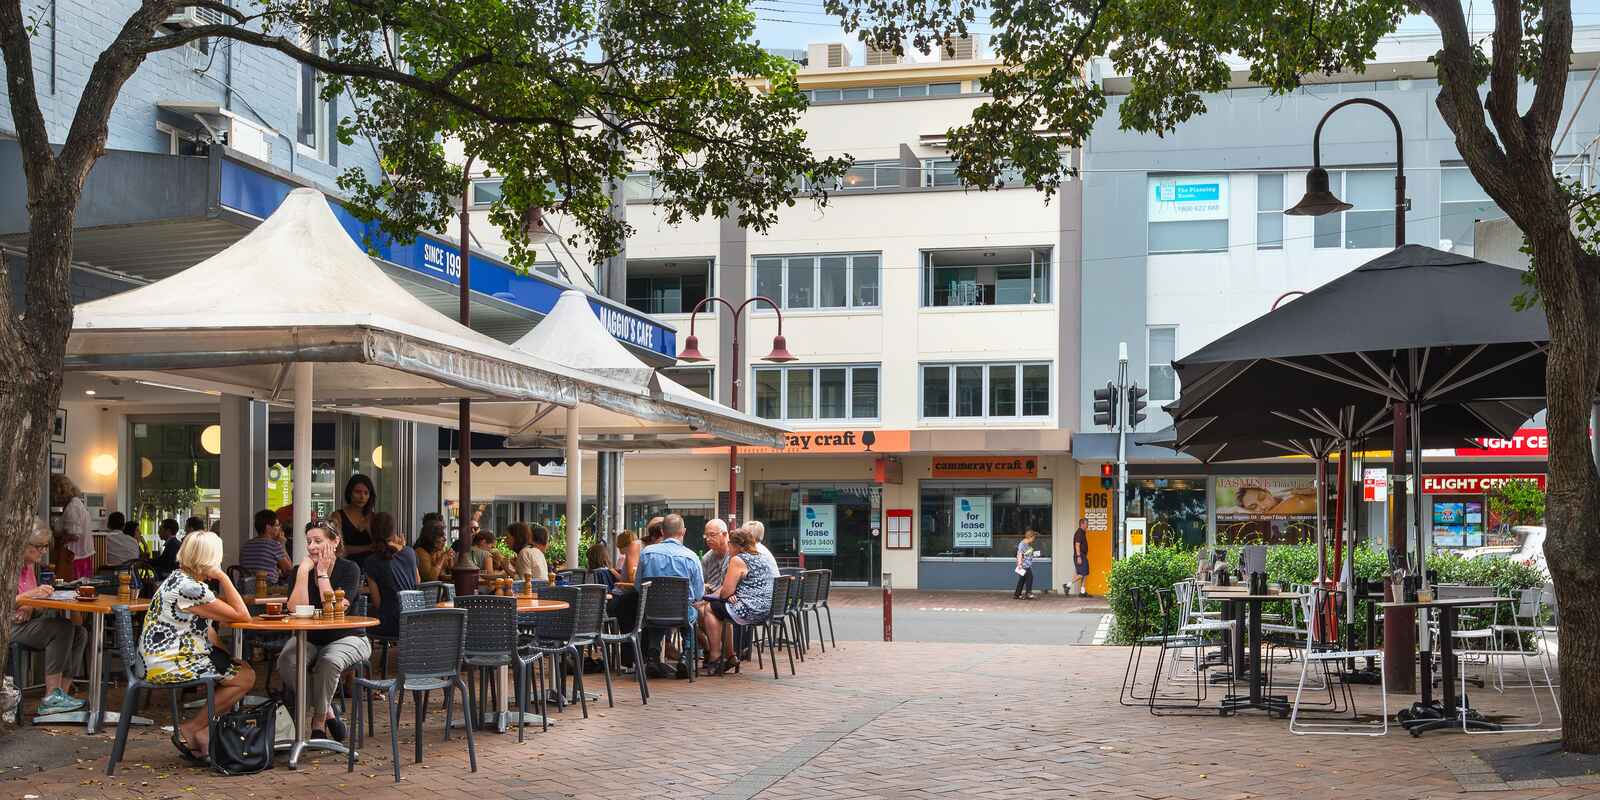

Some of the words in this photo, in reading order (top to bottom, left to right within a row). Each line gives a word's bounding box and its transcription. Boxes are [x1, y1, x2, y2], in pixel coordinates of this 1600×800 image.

[424, 243, 444, 267] SINCE
[446, 251, 462, 278] 199
[600, 306, 636, 343] MAGGIO'S
[636, 320, 654, 349] CAFE
[814, 431, 856, 446] craft
[935, 461, 993, 473] cammeray
[994, 459, 1023, 470] craft
[1424, 478, 1477, 490] FLIGHT
[1085, 493, 1108, 508] 506
[966, 512, 980, 520] for
[960, 521, 985, 529] lease
[805, 529, 829, 537] lease
